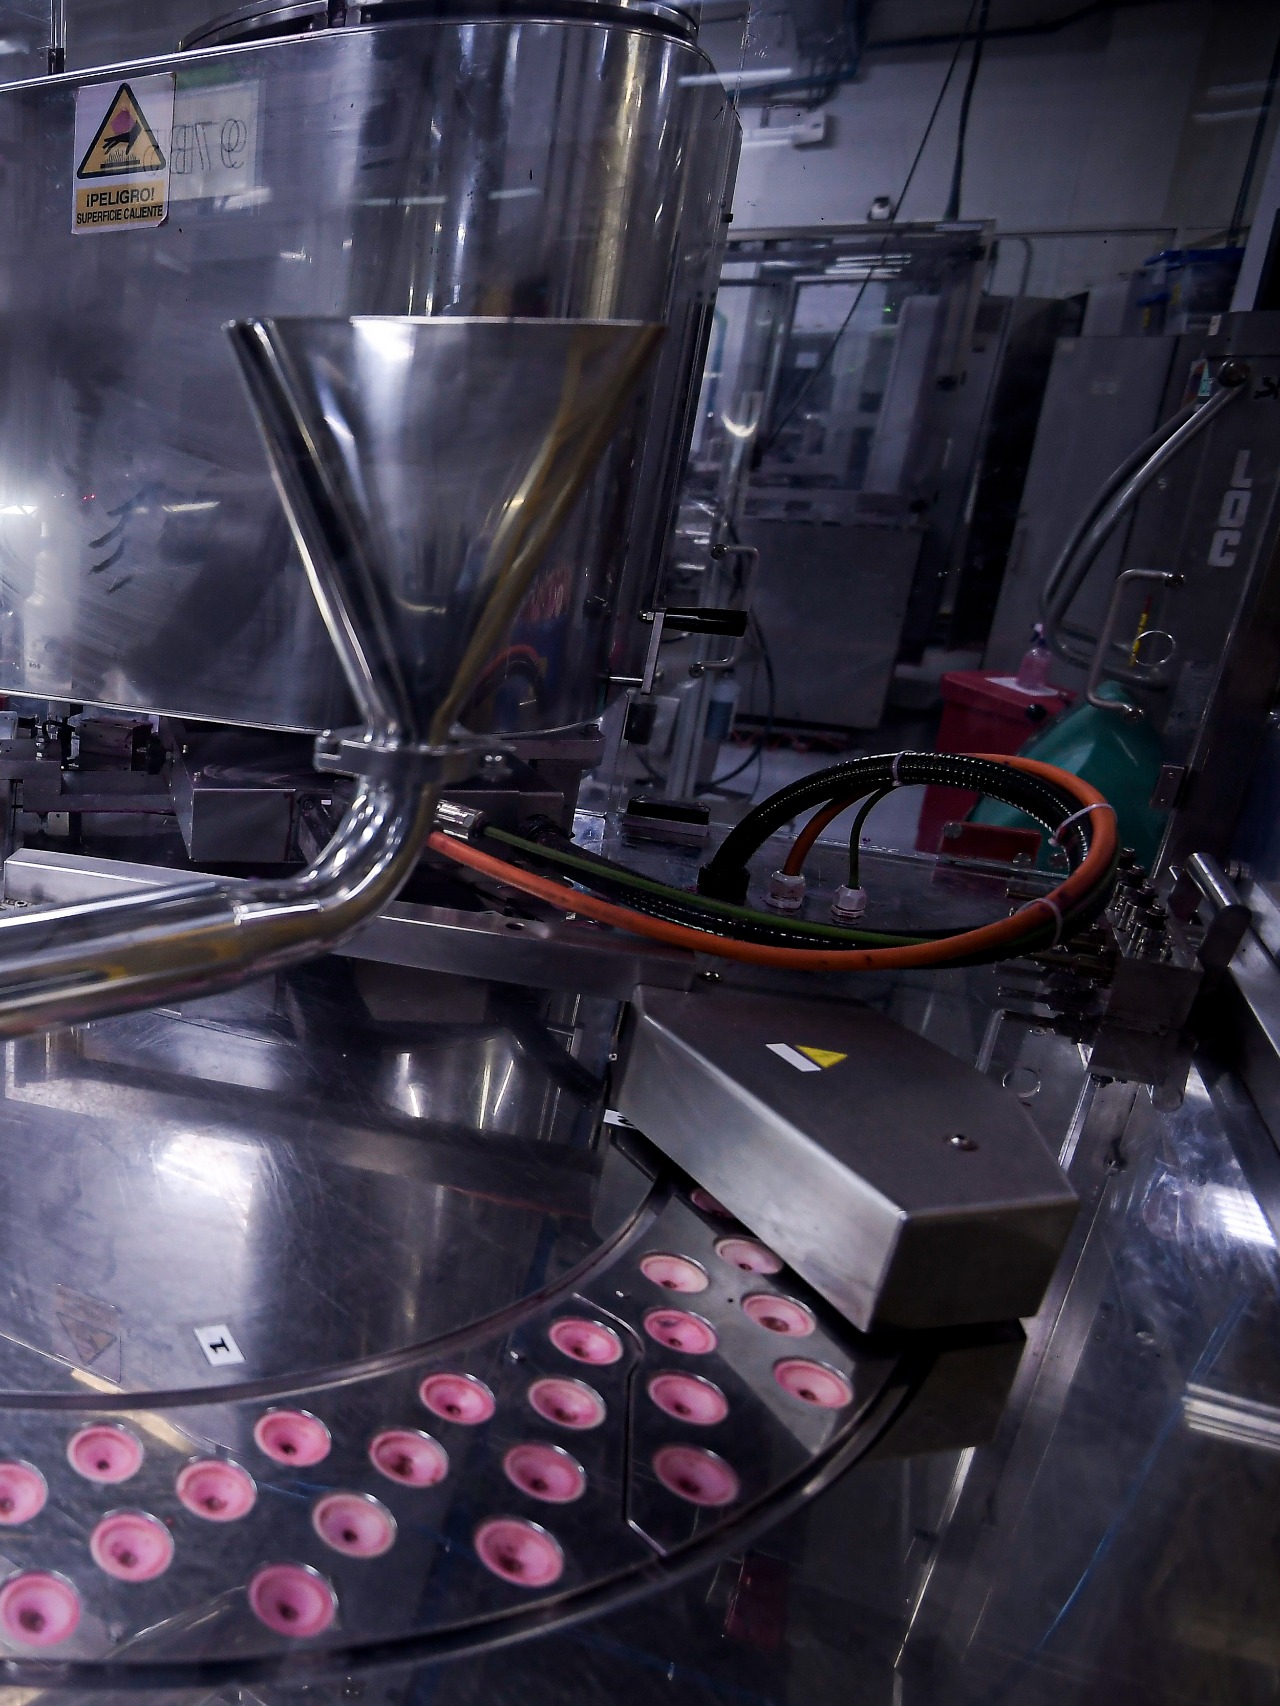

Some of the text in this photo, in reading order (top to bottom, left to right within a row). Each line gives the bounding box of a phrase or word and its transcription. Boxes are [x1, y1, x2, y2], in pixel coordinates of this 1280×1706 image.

[86, 187, 155, 208] ¡PELIGRO!
[76, 204, 163, 225] SUPERFICIE CALIENTE
[208, 1336, 230, 1354] 1
